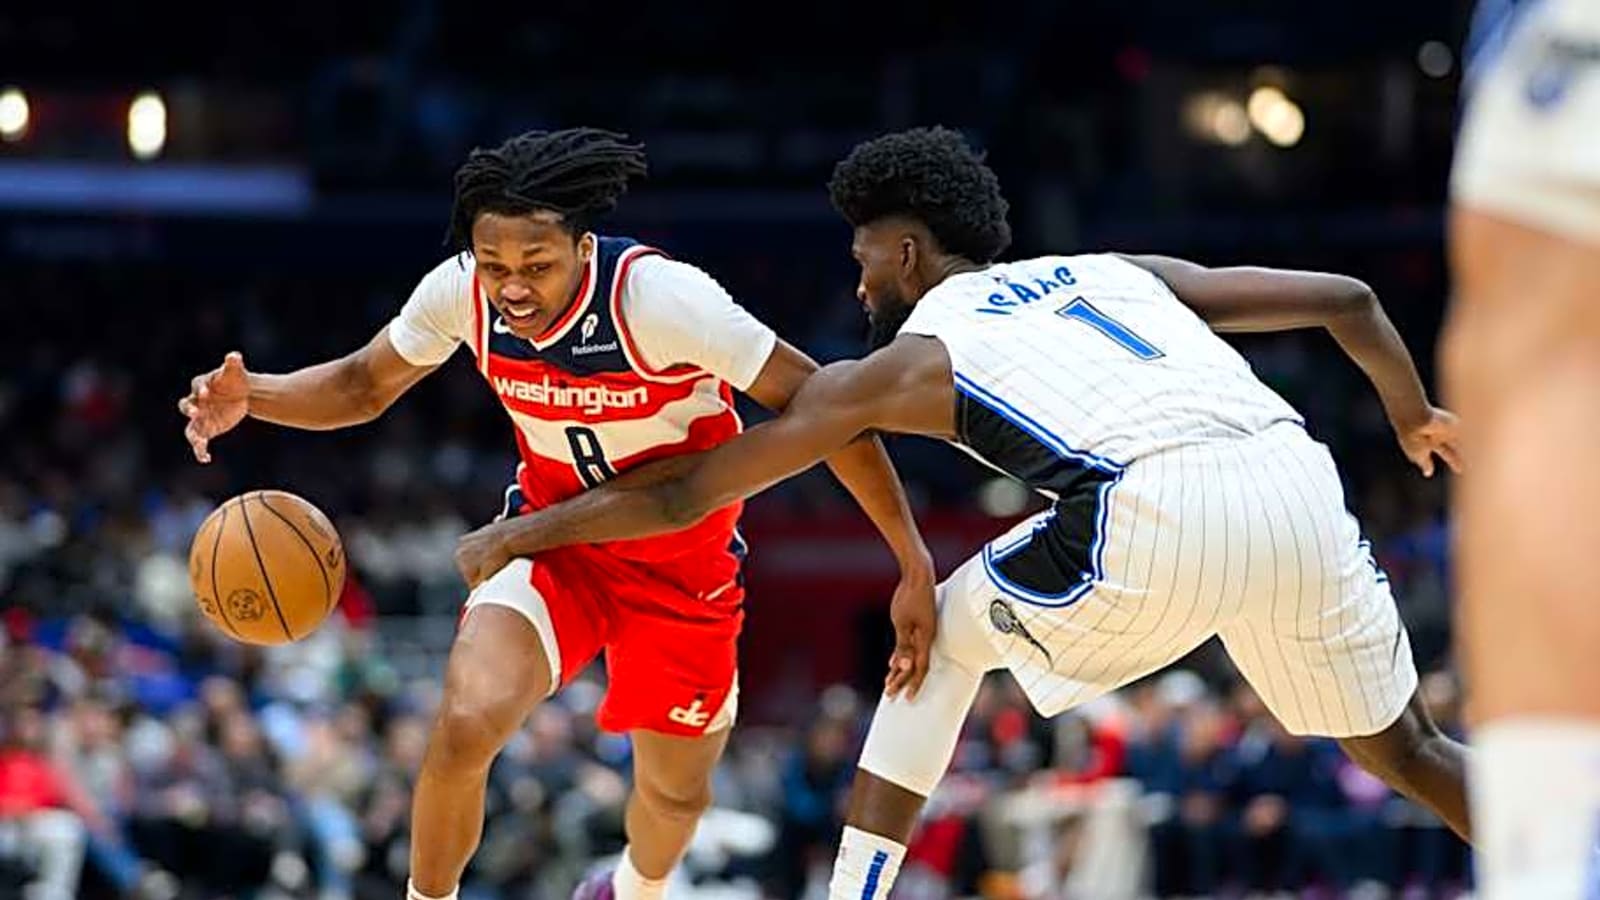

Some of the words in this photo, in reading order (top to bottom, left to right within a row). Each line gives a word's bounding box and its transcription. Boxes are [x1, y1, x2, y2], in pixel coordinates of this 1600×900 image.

[1054, 296, 1167, 360] 1
[494, 374, 648, 415] washington
[565, 426, 618, 488] 8
